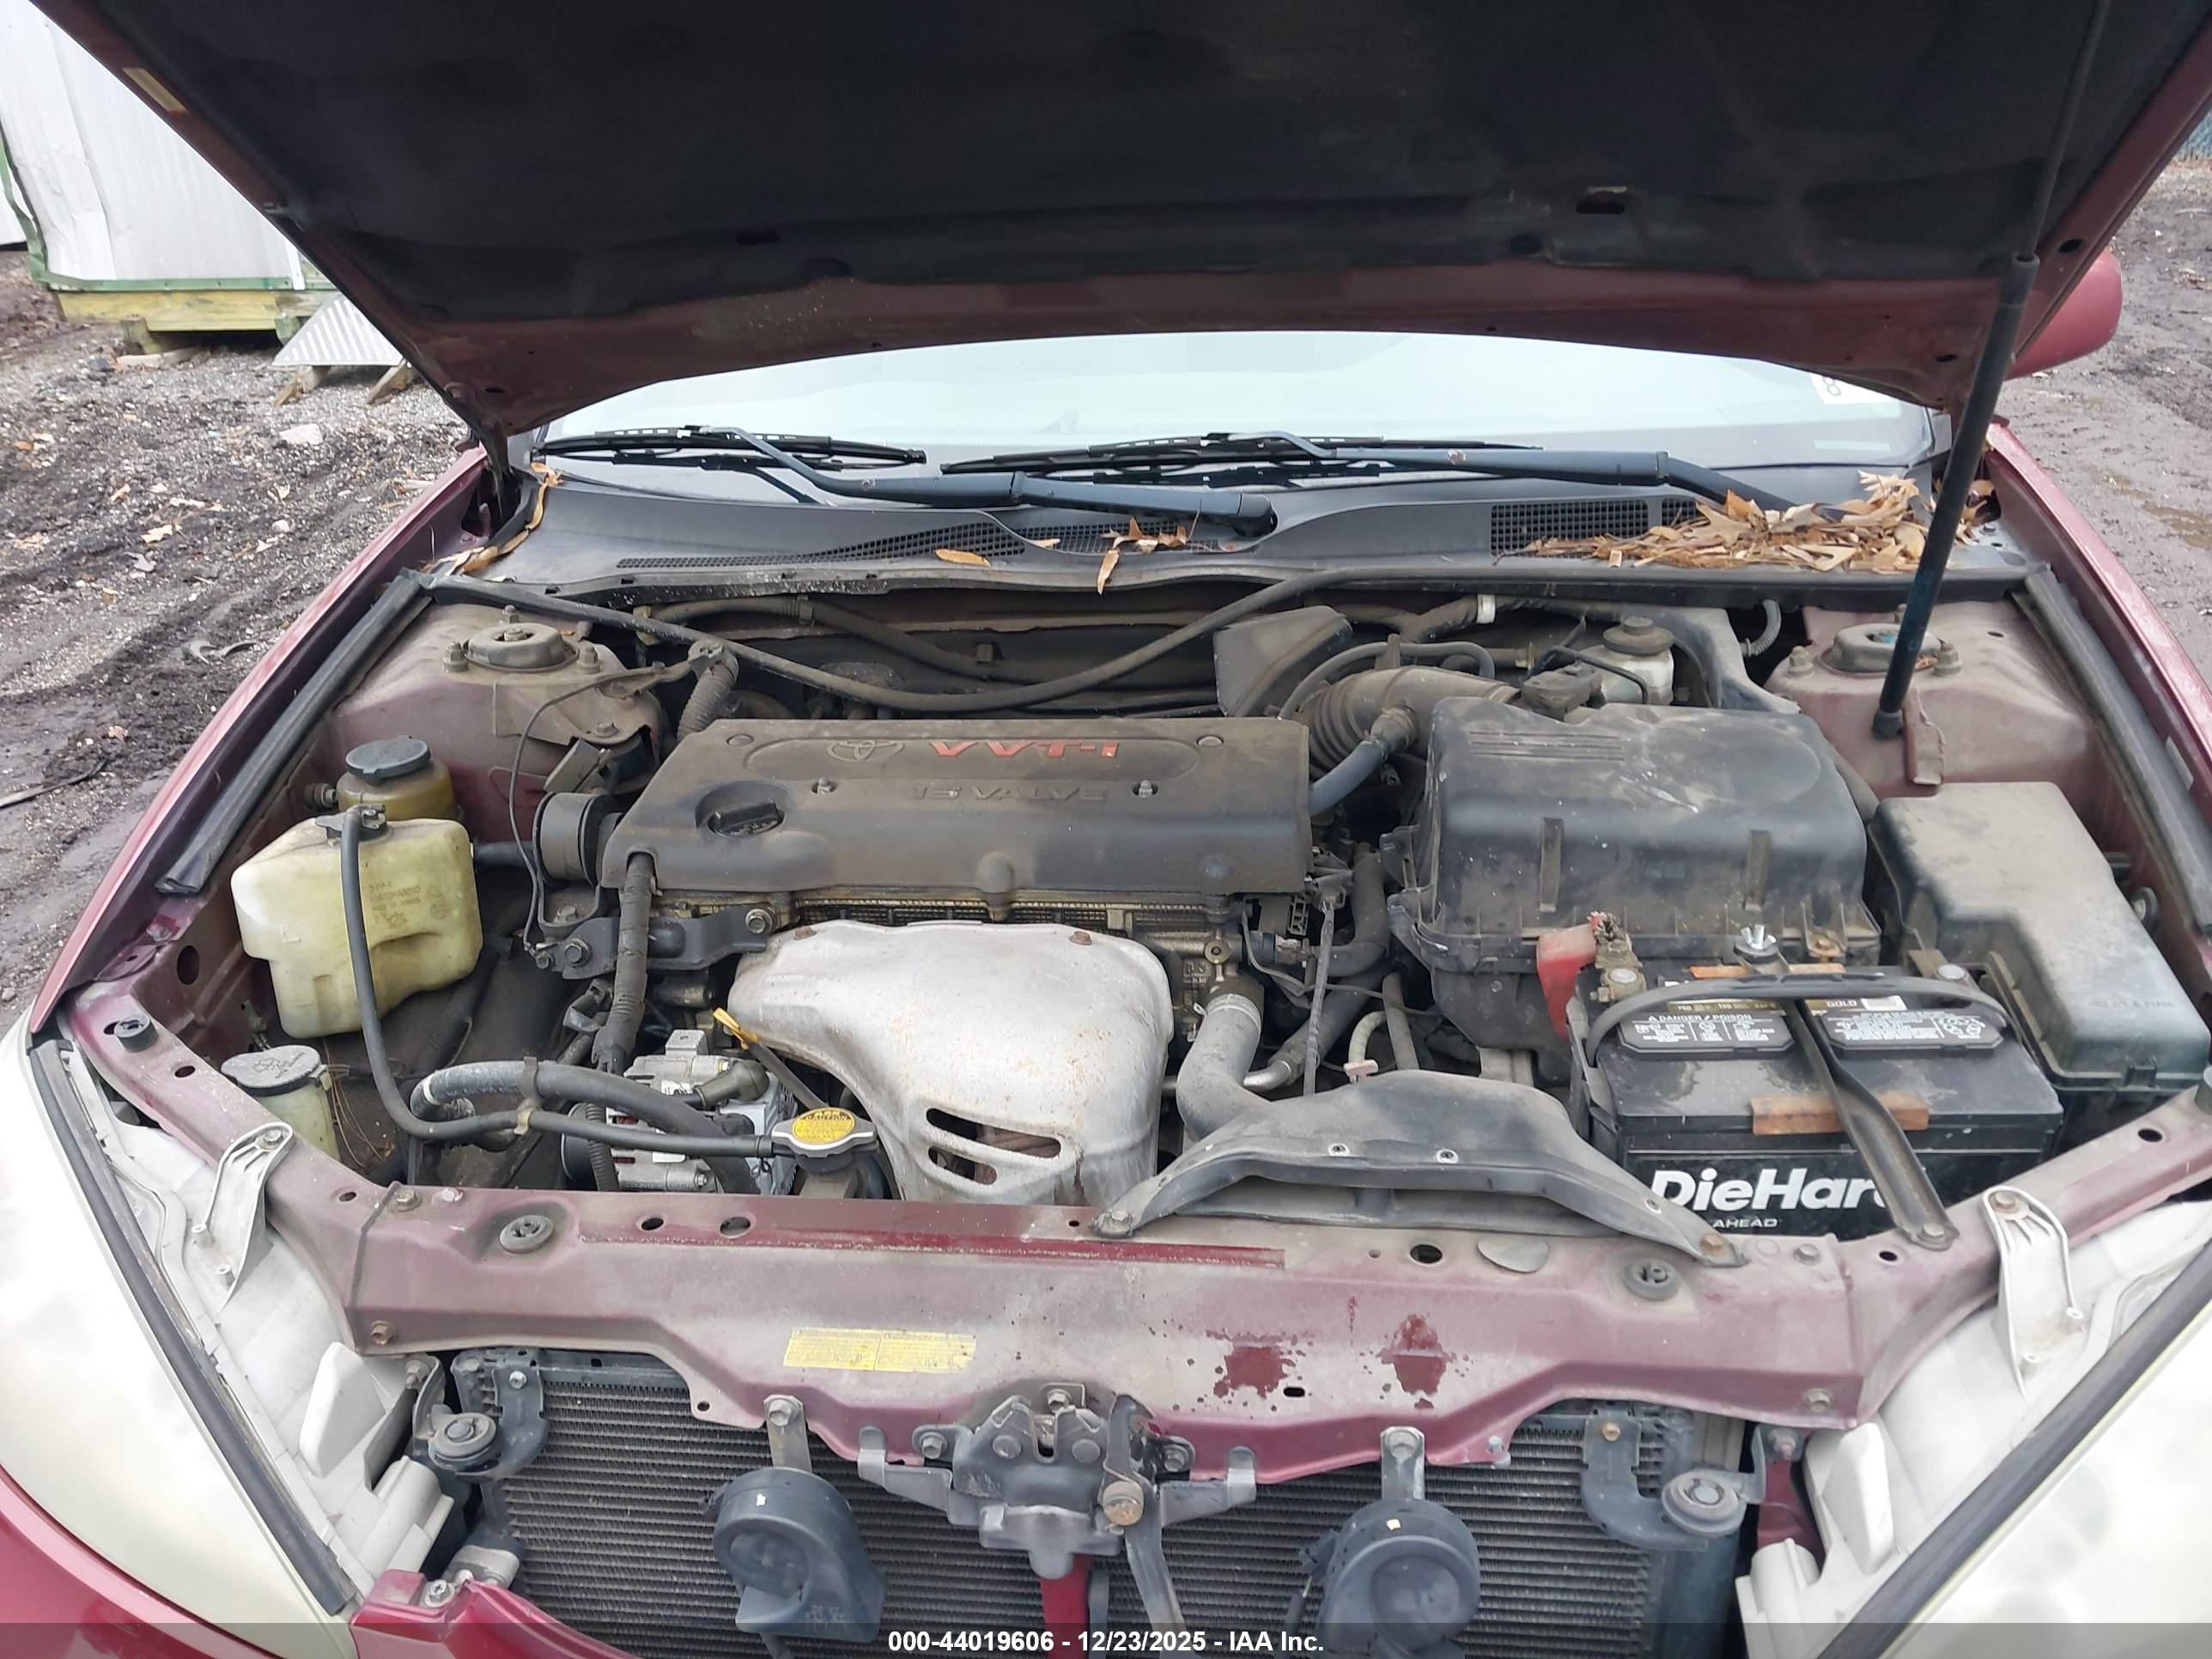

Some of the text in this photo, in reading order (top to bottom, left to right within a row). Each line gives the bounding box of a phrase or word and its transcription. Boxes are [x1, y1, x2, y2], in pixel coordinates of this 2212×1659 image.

[969, 786, 1111, 801] VALVE
[1826, 1000, 1857, 1008] GOLD
[1658, 1014, 1702, 1023] DANGER
[1650, 1168, 1887, 1212] DieHar
[1711, 1217, 1779, 1228] AHEAD
